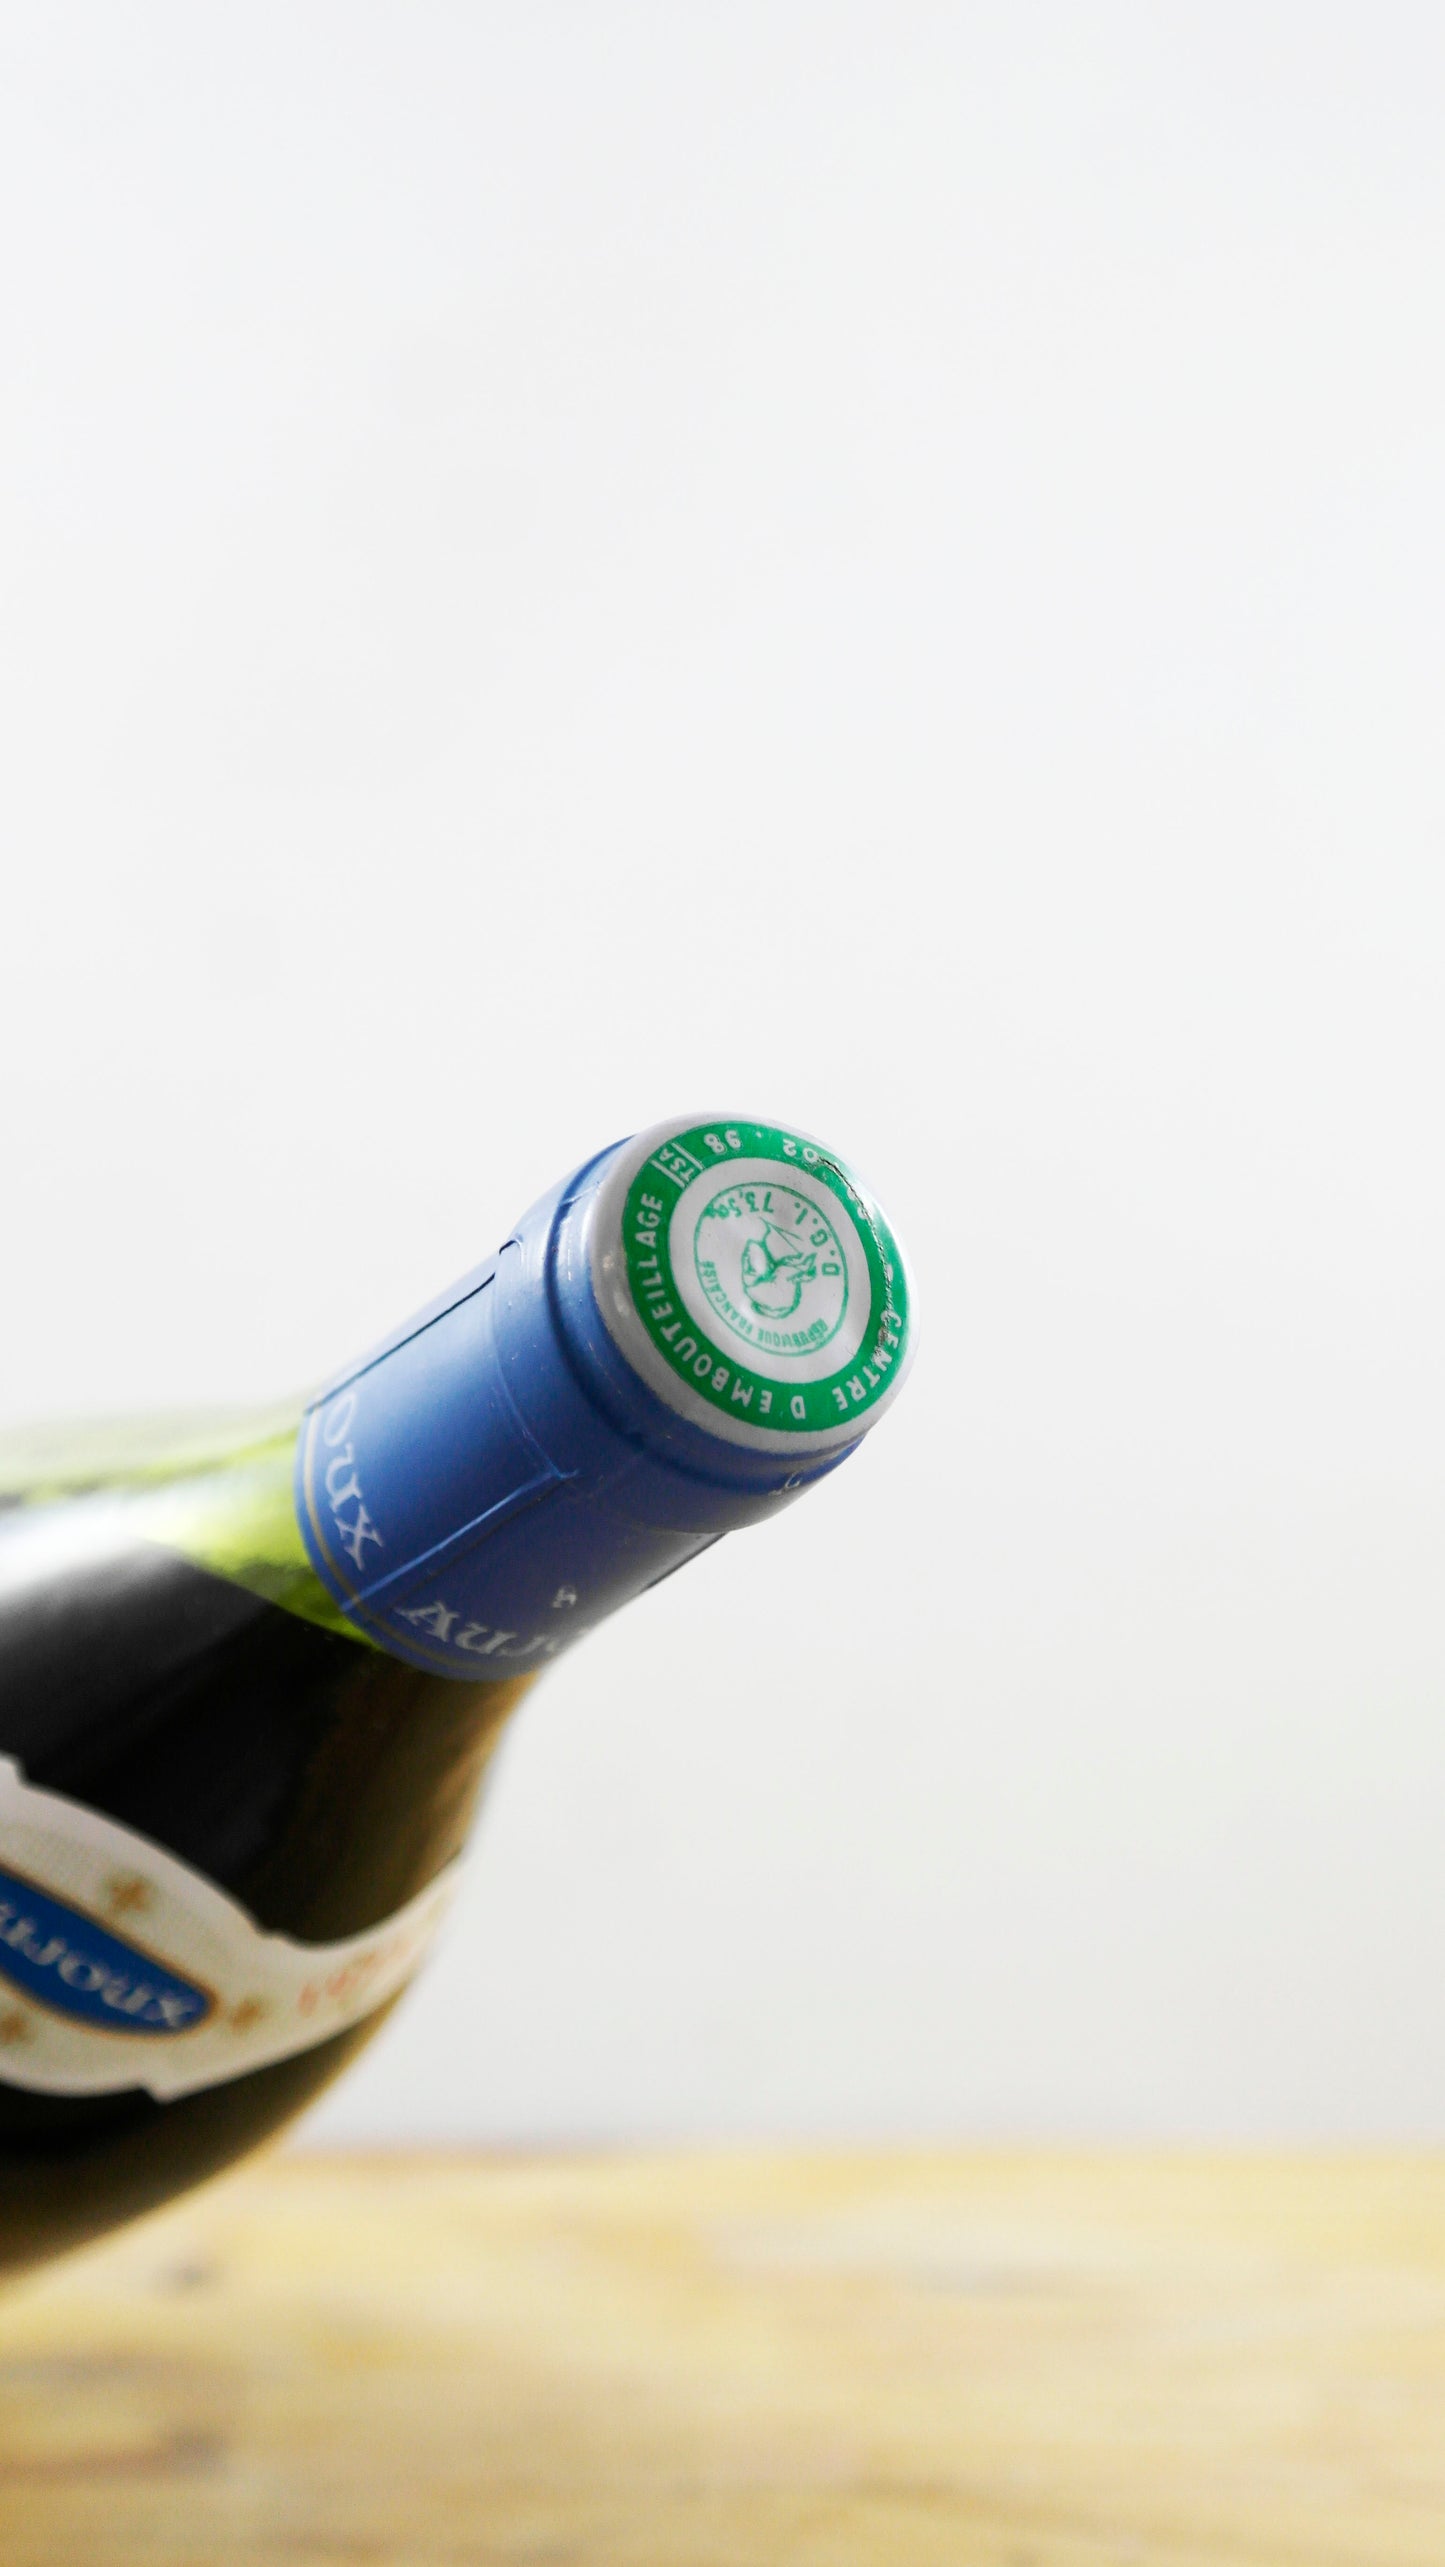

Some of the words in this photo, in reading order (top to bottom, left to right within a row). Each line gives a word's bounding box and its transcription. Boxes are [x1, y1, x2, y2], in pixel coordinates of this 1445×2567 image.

[658, 1148, 696, 1182] TSA
[703, 1129, 742, 1154] 98
[793, 1201, 841, 1277] D.G.I.
[635, 1192, 772, 1414] EMBOUTEILLAGE
[835, 1308, 903, 1412] CENTRE
